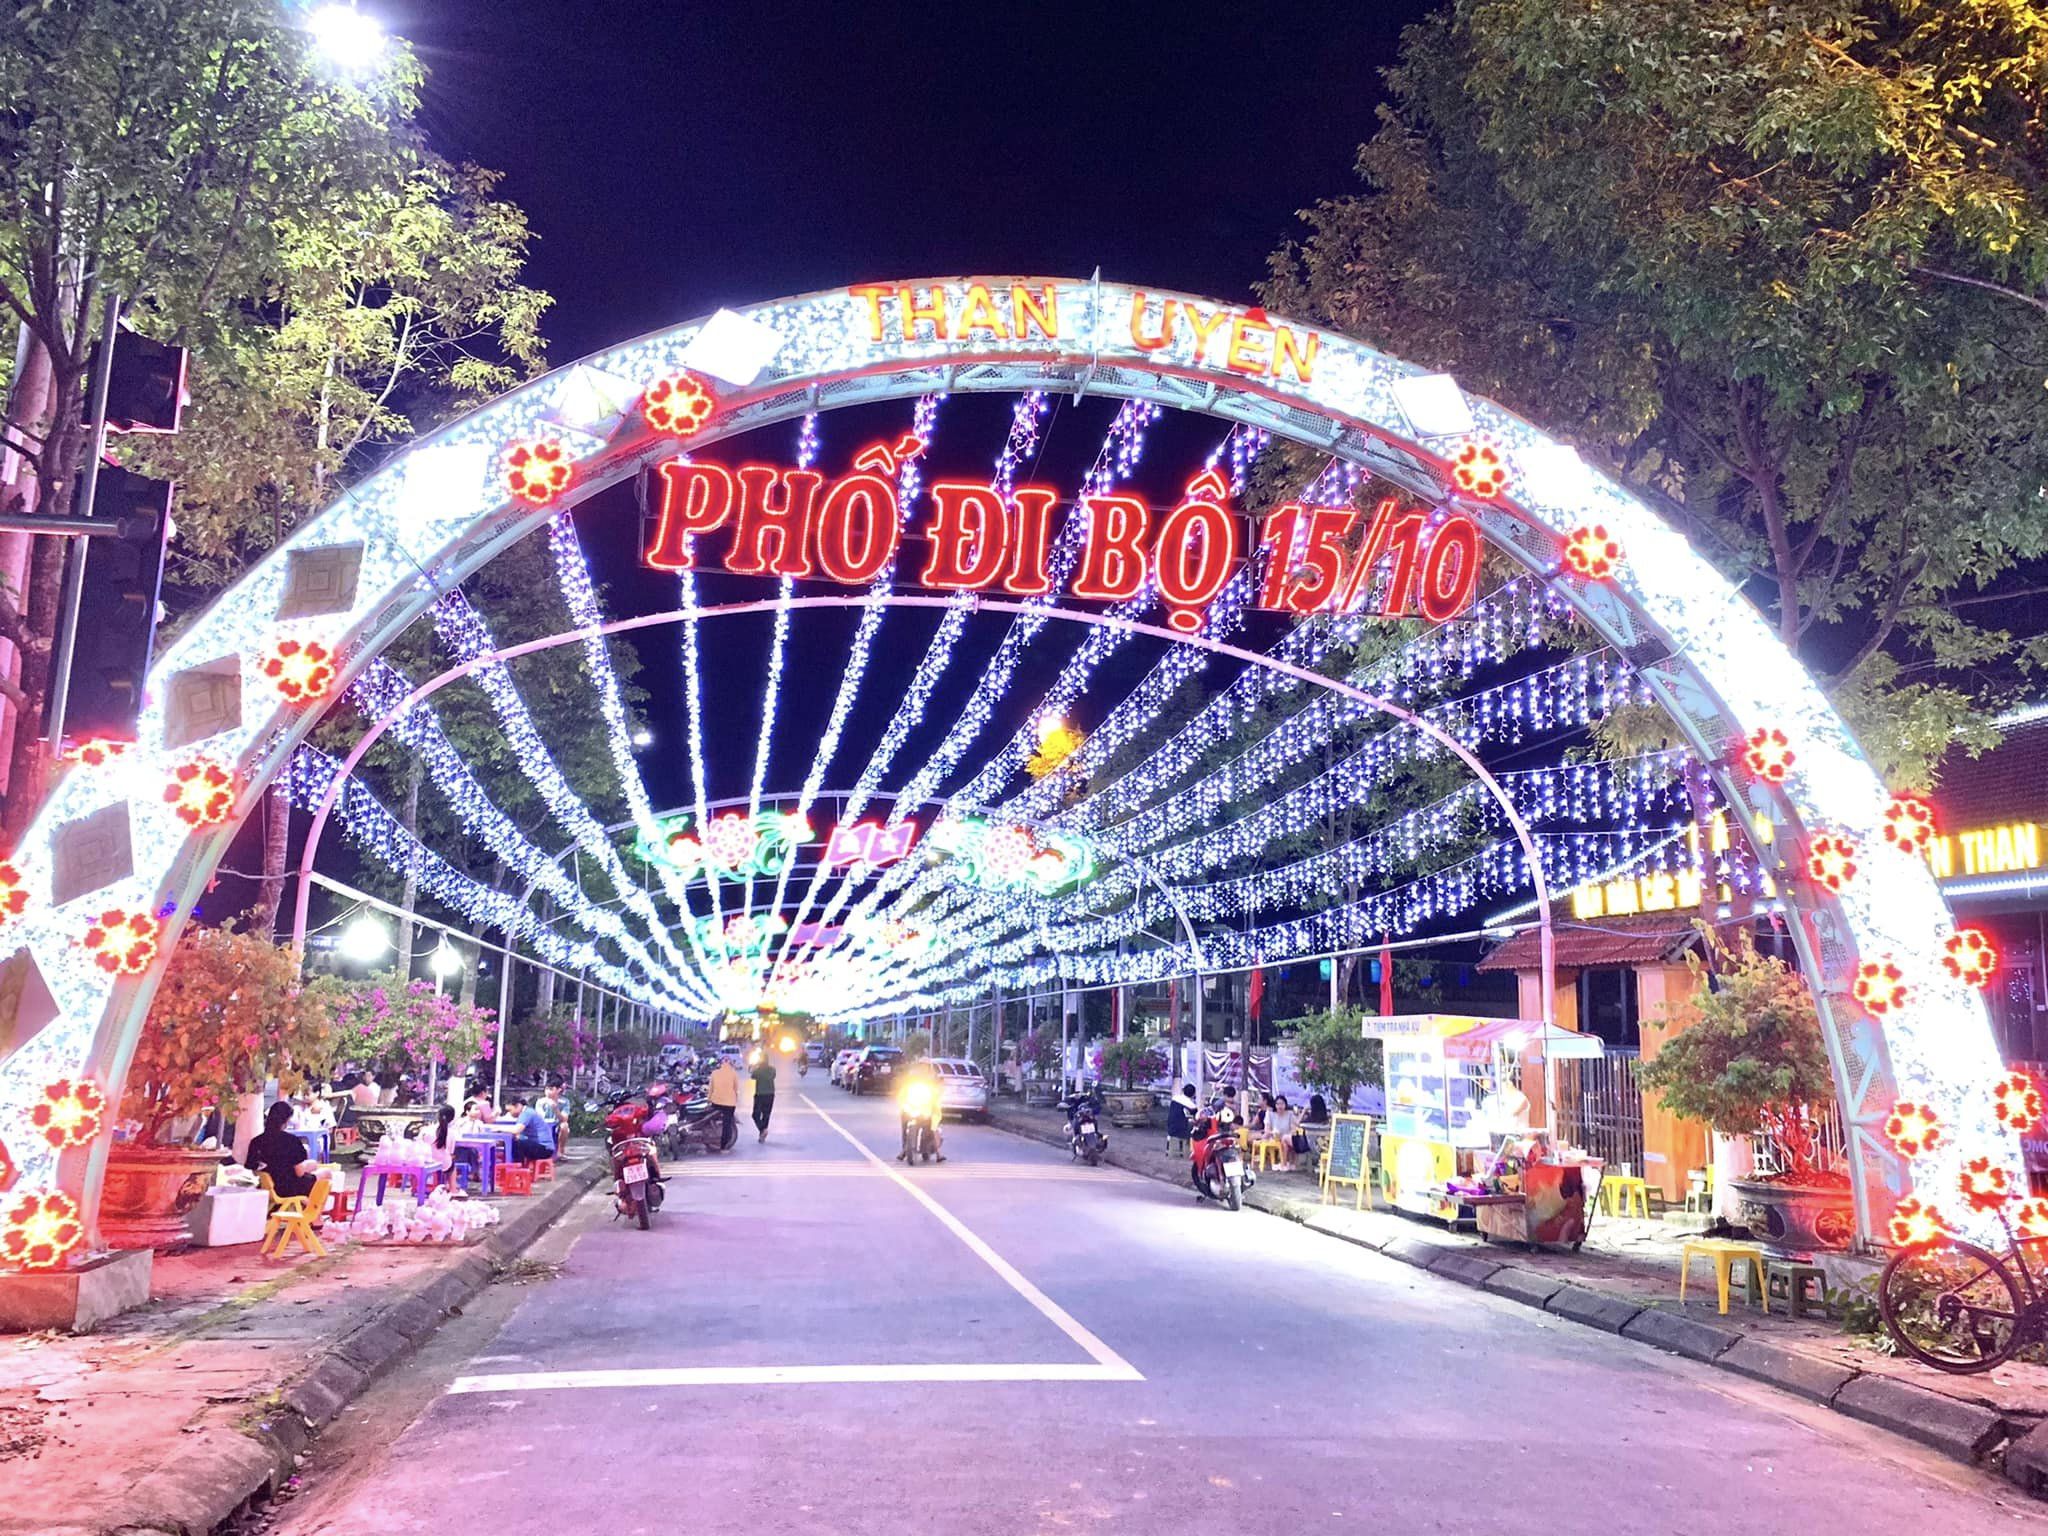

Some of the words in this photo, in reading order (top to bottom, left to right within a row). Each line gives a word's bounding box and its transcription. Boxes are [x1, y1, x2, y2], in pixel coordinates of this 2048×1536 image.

[849, 283, 1057, 341] THAN
[1130, 291, 1319, 383] UYÊN
[647, 436, 923, 584] PHỐ
[922, 484, 1056, 593] ĐI
[1073, 471, 1232, 632] BỘ
[1258, 501, 1479, 622] 15/10
[1959, 822, 2039, 875] THAN
